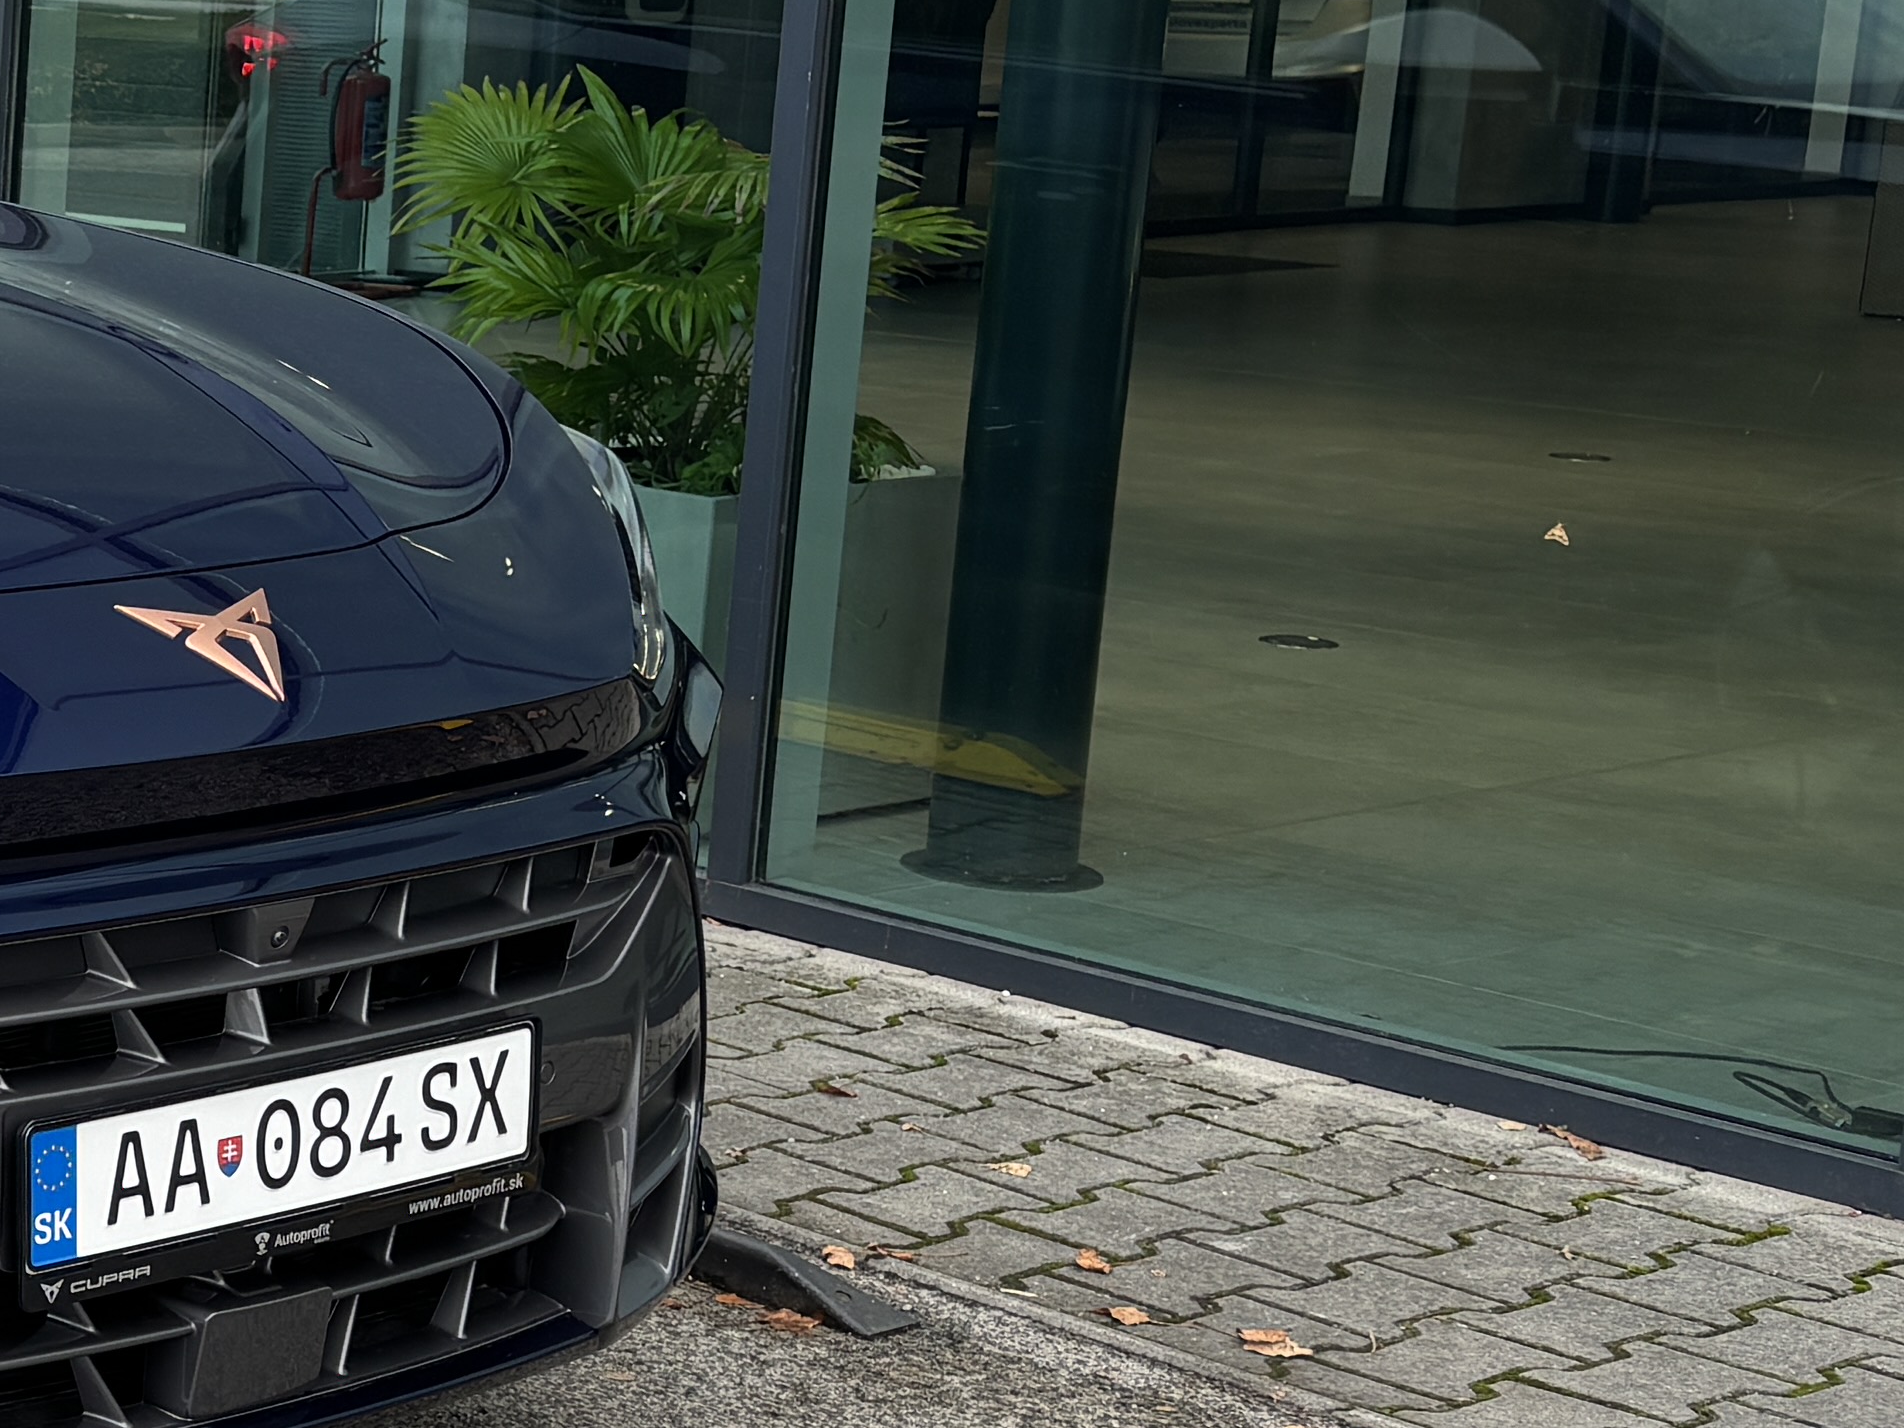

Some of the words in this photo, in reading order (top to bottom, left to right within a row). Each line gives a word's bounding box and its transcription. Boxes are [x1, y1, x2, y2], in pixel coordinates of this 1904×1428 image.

[408, 1172, 525, 1216] www.autoprofit.sk
[34, 1207, 73, 1247] SK
[274, 1222, 331, 1249] Autoprofit
[70, 1264, 151, 1295] CUPRA
